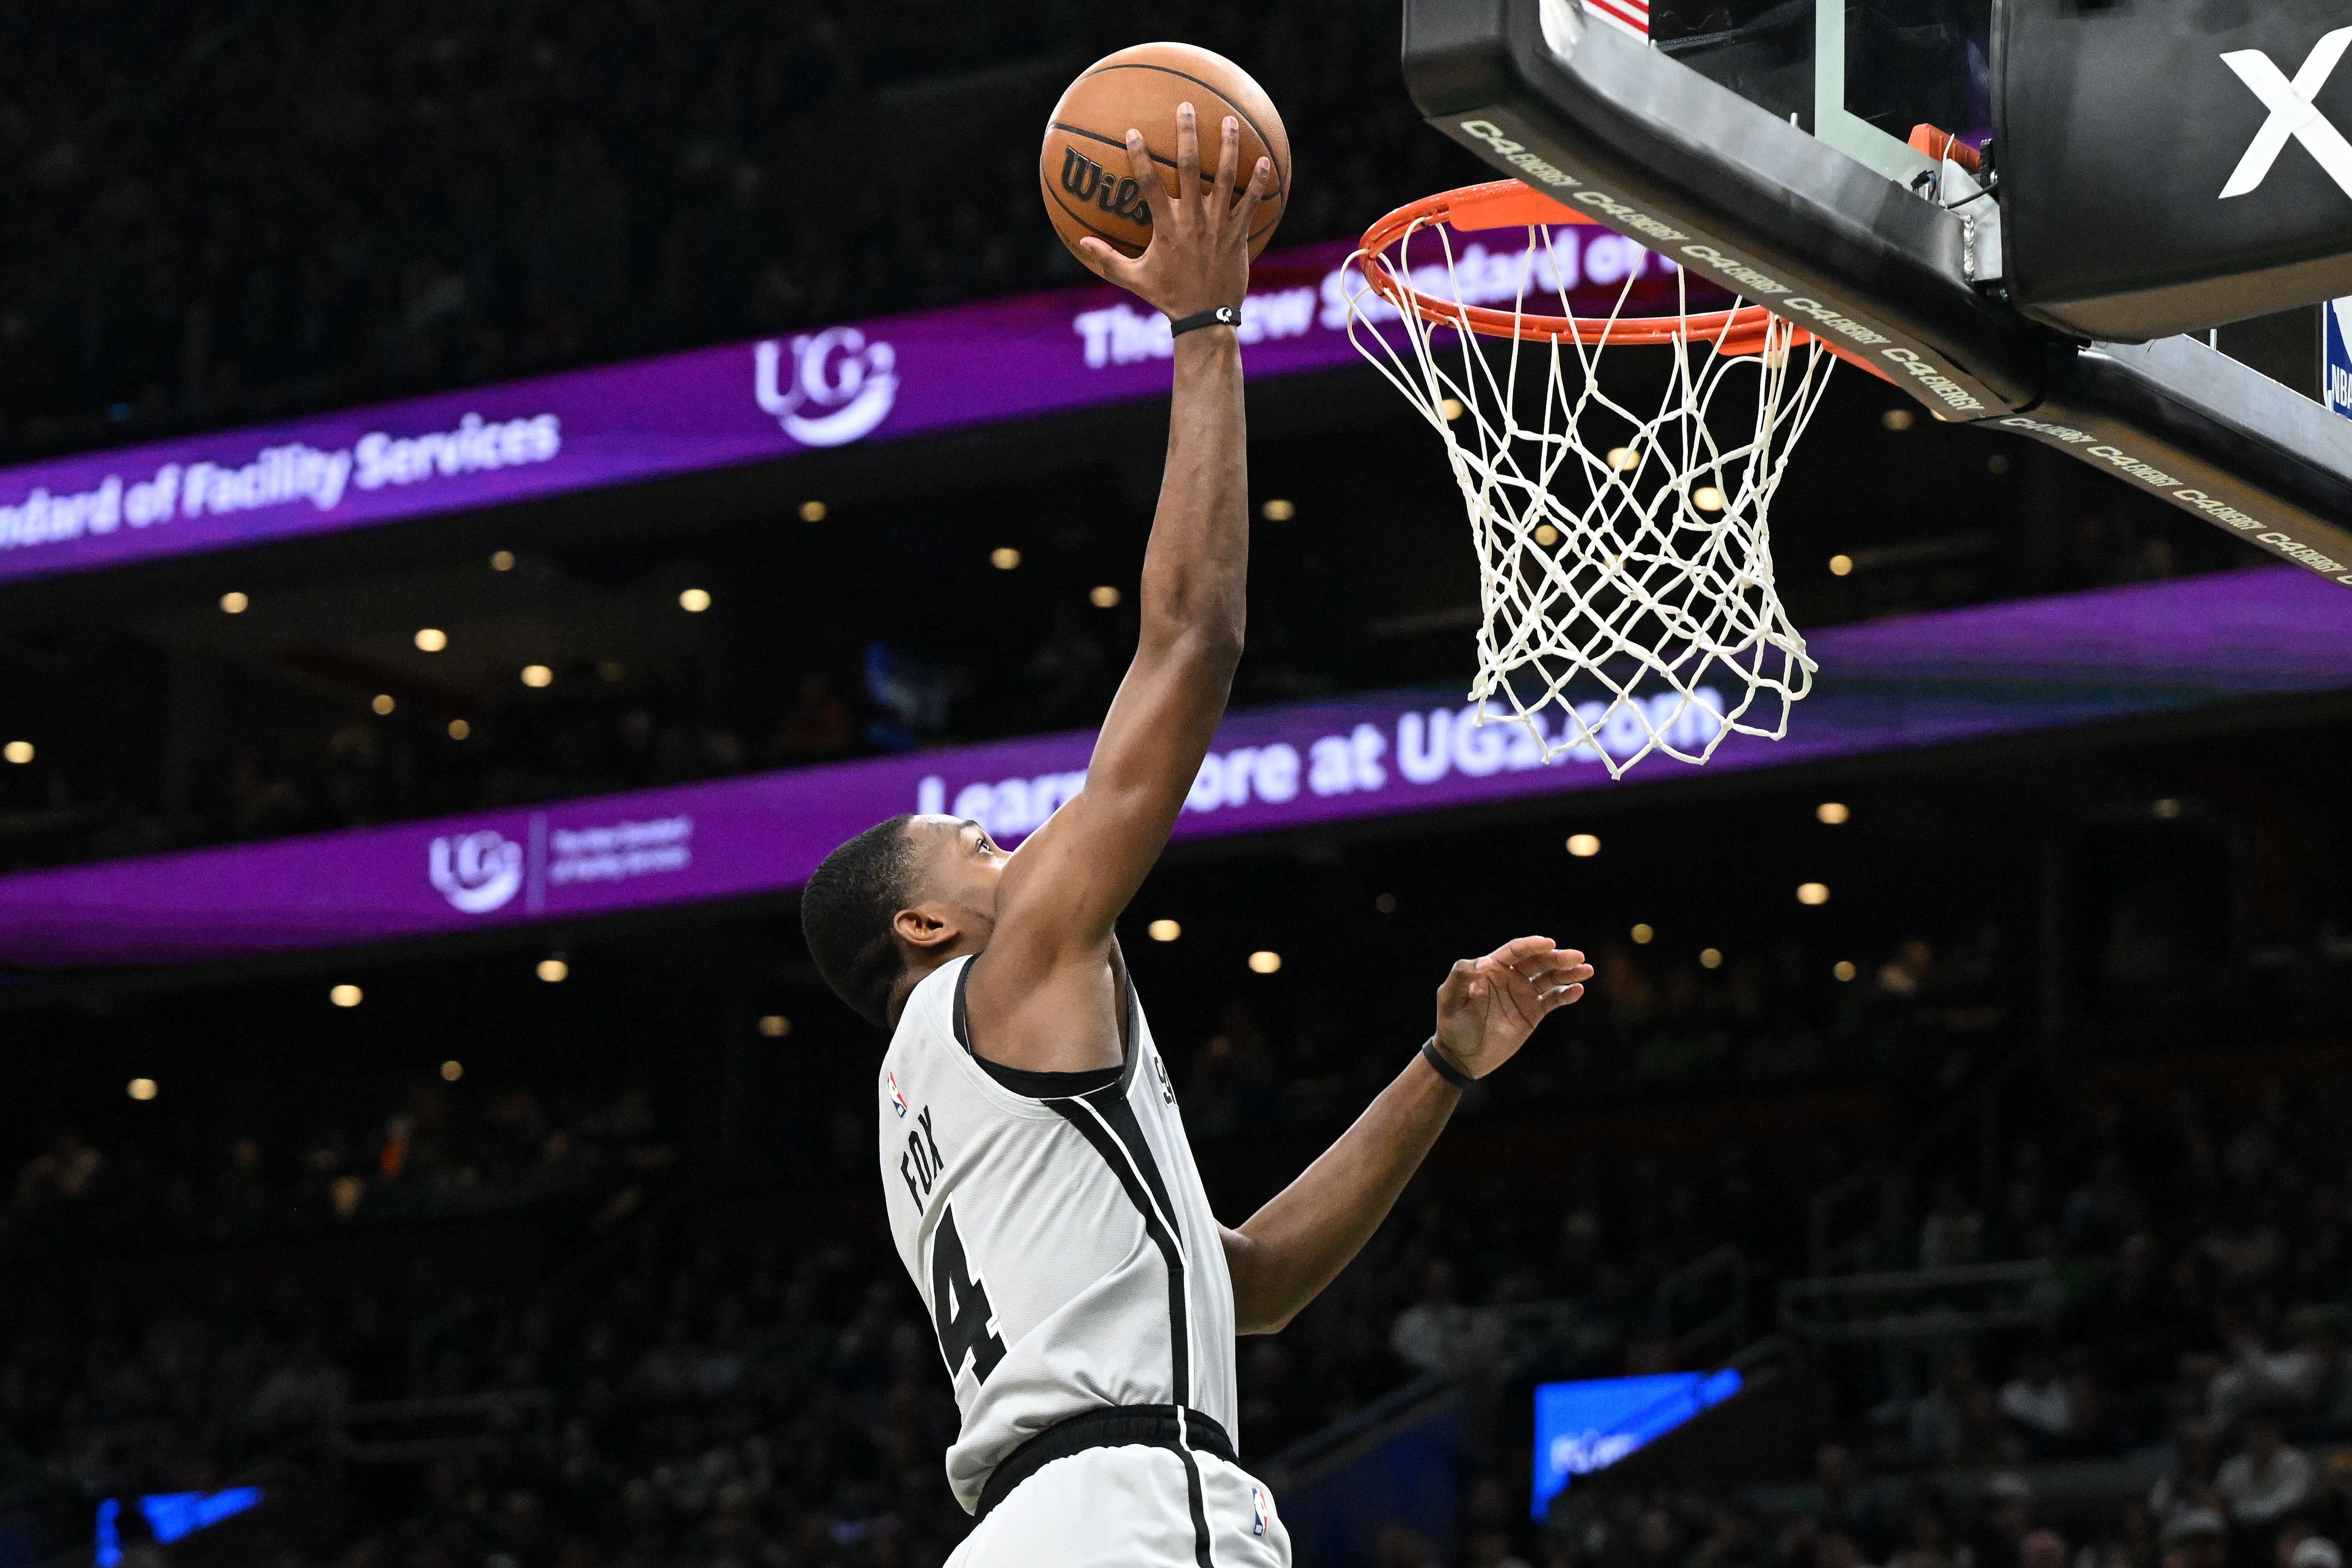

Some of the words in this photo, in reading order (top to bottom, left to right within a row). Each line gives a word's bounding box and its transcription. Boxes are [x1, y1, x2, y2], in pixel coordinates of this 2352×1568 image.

[1238, 286, 1317, 344] ew
[182, 442, 353, 519] Facility
[354, 411, 560, 490] Services
[1184, 742, 1301, 813] ore
[1307, 722, 1388, 797] at
[900, 1105, 944, 1218] FOX
[929, 1192, 1012, 1390] 4
